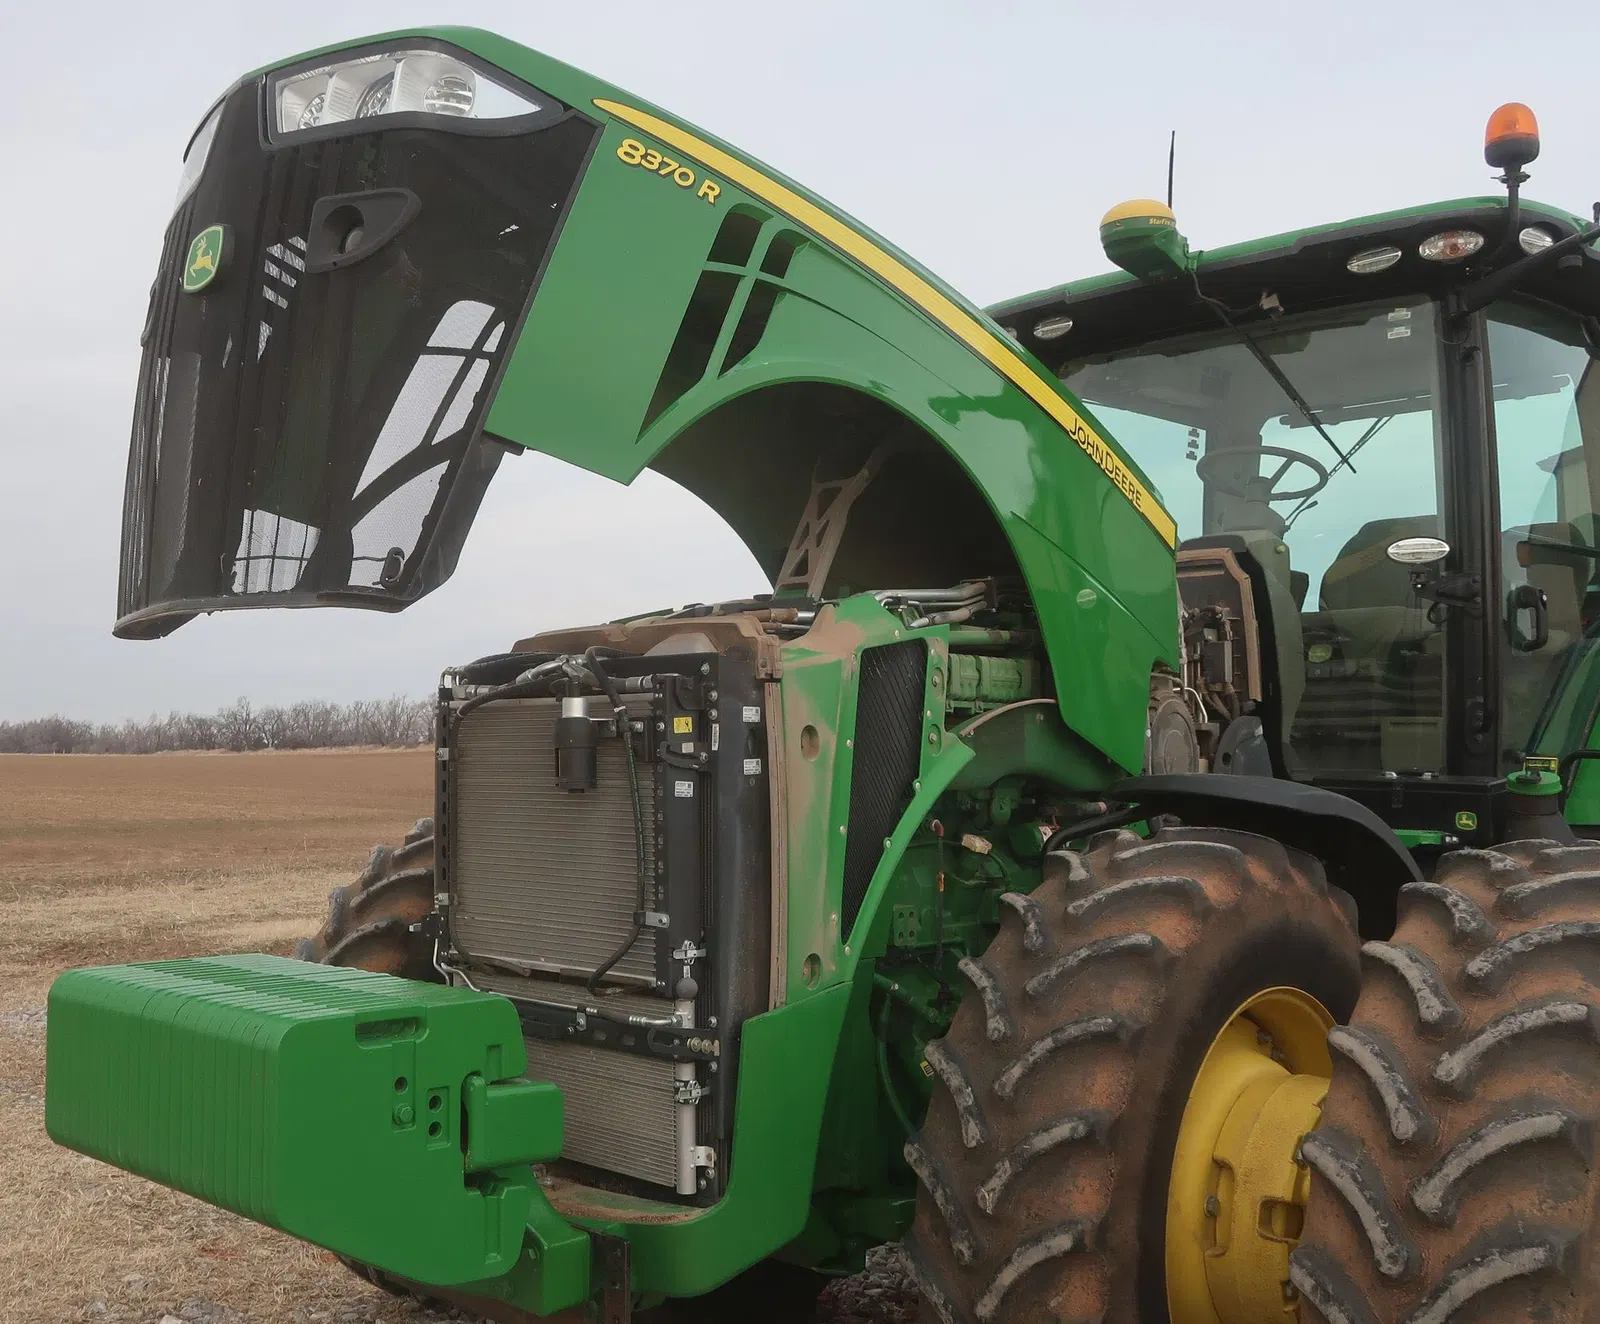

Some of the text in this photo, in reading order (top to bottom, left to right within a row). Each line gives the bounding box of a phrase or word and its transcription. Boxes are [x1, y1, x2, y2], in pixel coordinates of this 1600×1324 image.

[616, 138, 721, 204] 8370 R
[1069, 417, 1142, 510] JOHN DEERE
